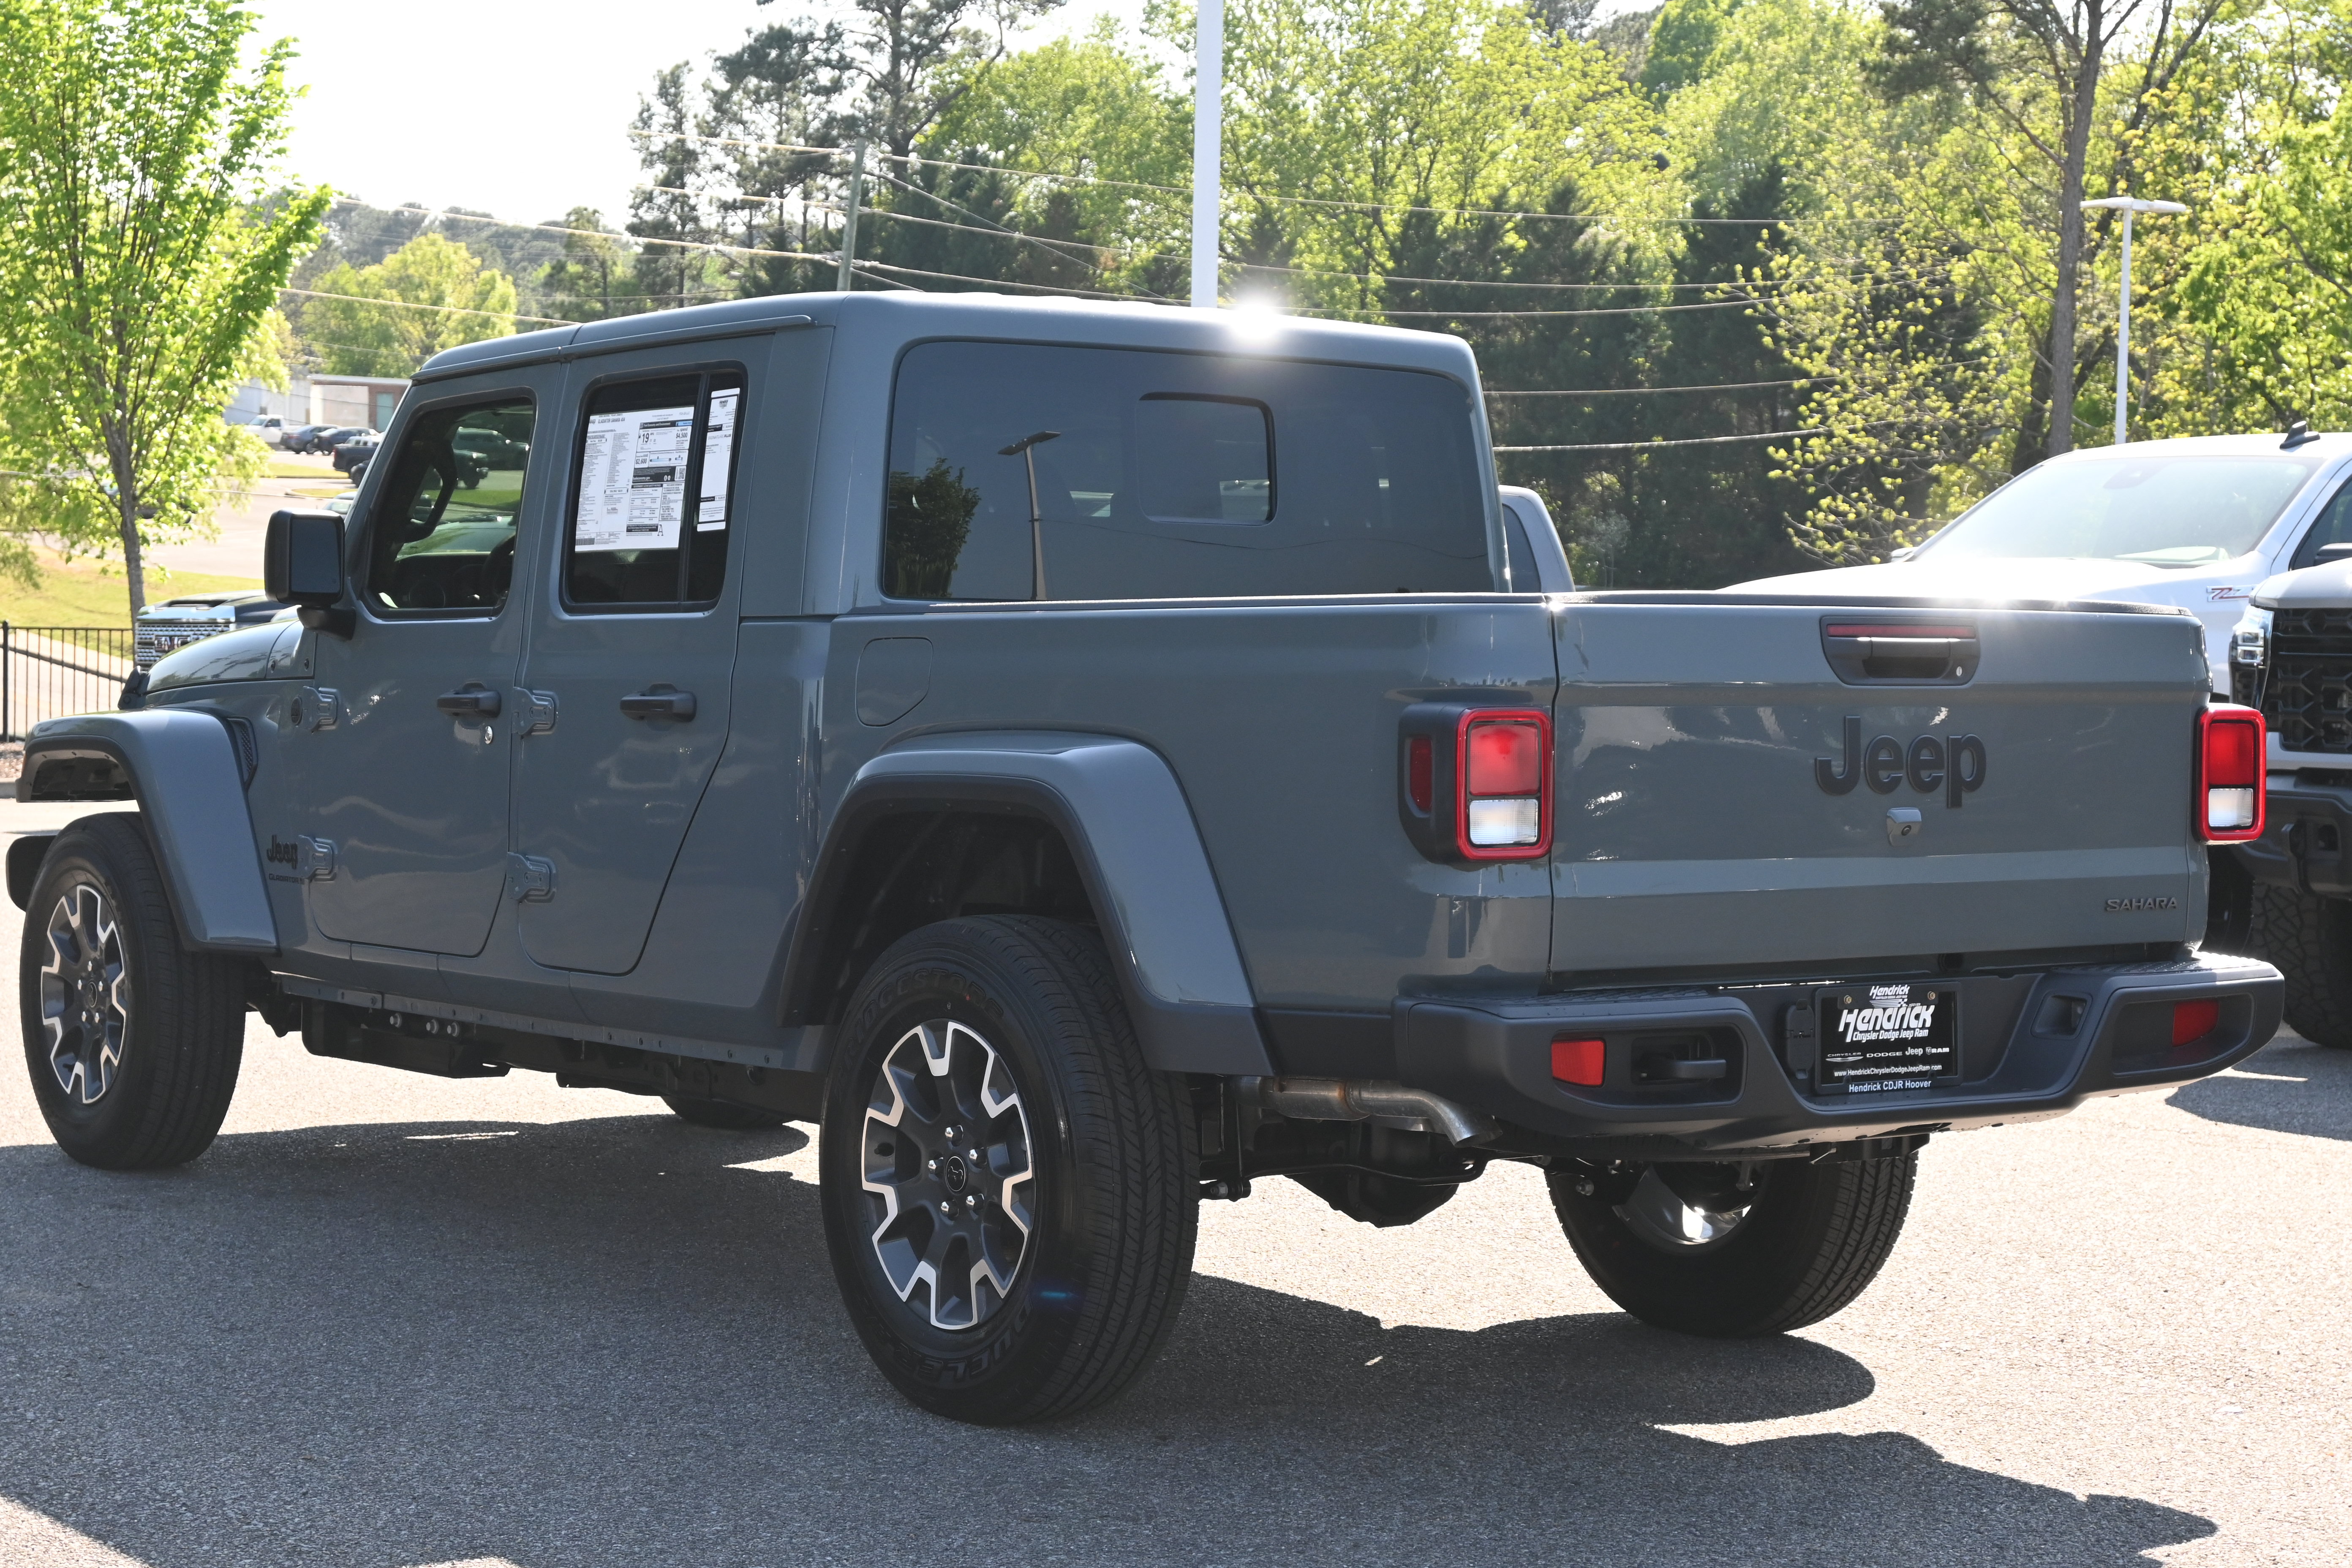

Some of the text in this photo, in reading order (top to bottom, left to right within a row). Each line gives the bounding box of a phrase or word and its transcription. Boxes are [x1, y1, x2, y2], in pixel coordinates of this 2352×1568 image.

[642, 433, 649, 444] 19
[657, 524, 664, 536] A
[1815, 716, 1987, 809] Jeep
[267, 834, 298, 869] Jeep
[269, 873, 299, 884] GLADIATOR
[2105, 897, 2178, 912] SAHARA
[1869, 984, 1910, 999] Hendrick
[1838, 1005, 1935, 1043] Hendrick
[1852, 1028, 1929, 1043] Chrysler Dodge Jeep Ram
[1905, 1046, 1923, 1056] Jeep
[1834, 1064, 1942, 1077] wwwHendrickChryslerDodgeJeepRamcom
[1849, 1080, 1932, 1093] Hendrick CDJR Hoover
